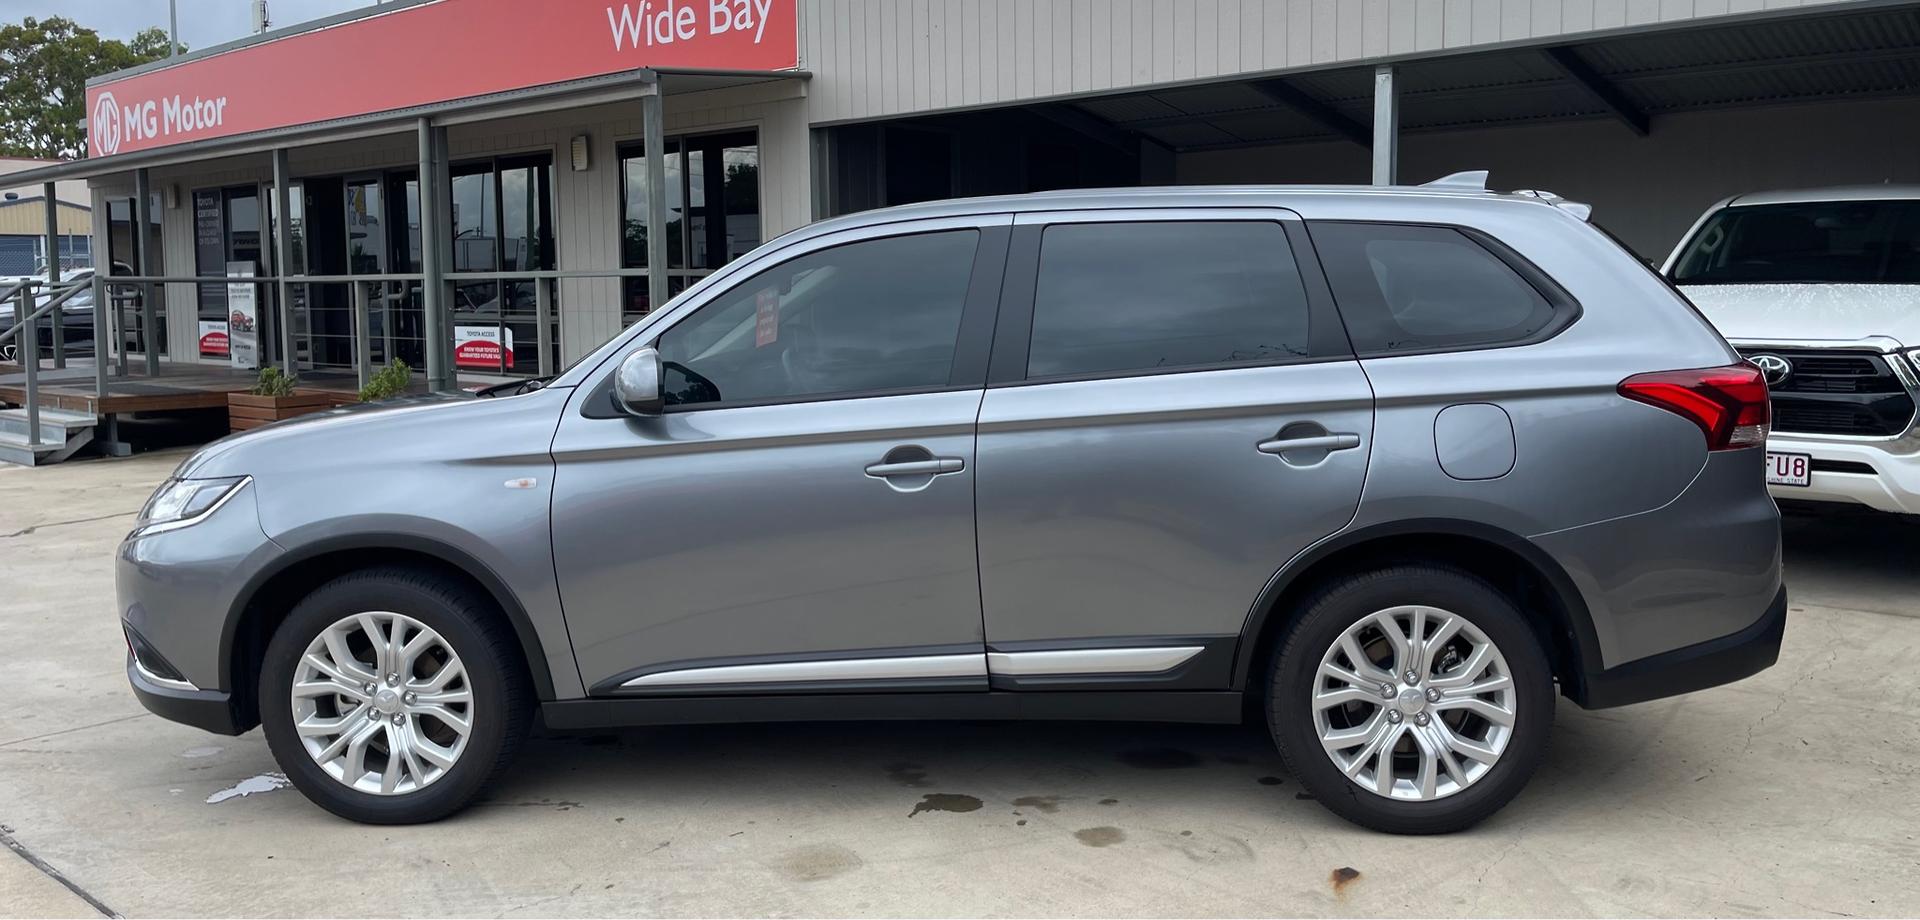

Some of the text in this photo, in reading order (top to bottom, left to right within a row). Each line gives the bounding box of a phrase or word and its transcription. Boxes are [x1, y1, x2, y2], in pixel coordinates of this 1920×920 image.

[606, 0, 773, 51] Wide Bay
[124, 94, 227, 142] MG Motor
